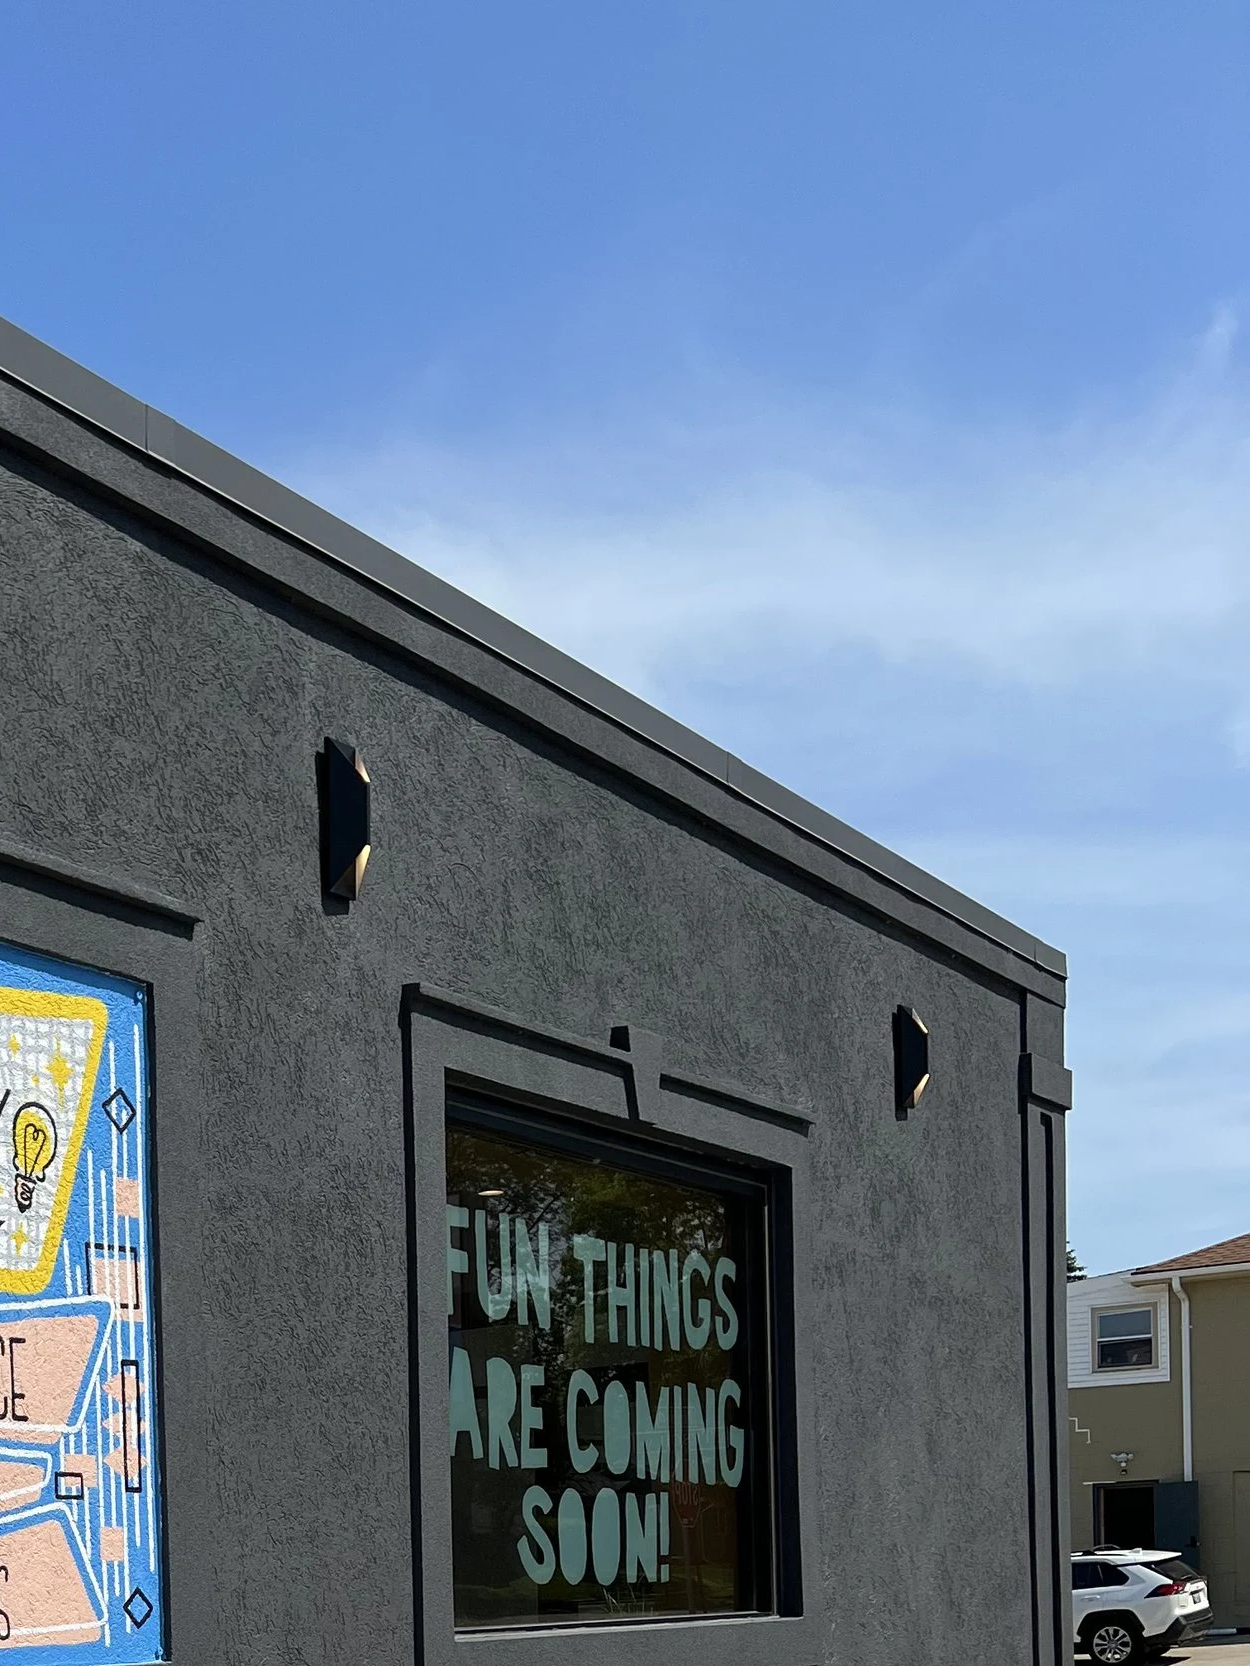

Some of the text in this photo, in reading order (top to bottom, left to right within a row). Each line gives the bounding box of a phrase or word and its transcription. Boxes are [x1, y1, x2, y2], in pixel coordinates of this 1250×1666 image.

[446, 1204, 739, 1352] FUN THINGS
[449, 1346, 745, 1488] ARE COMING
[517, 1485, 670, 1586] SOON!
